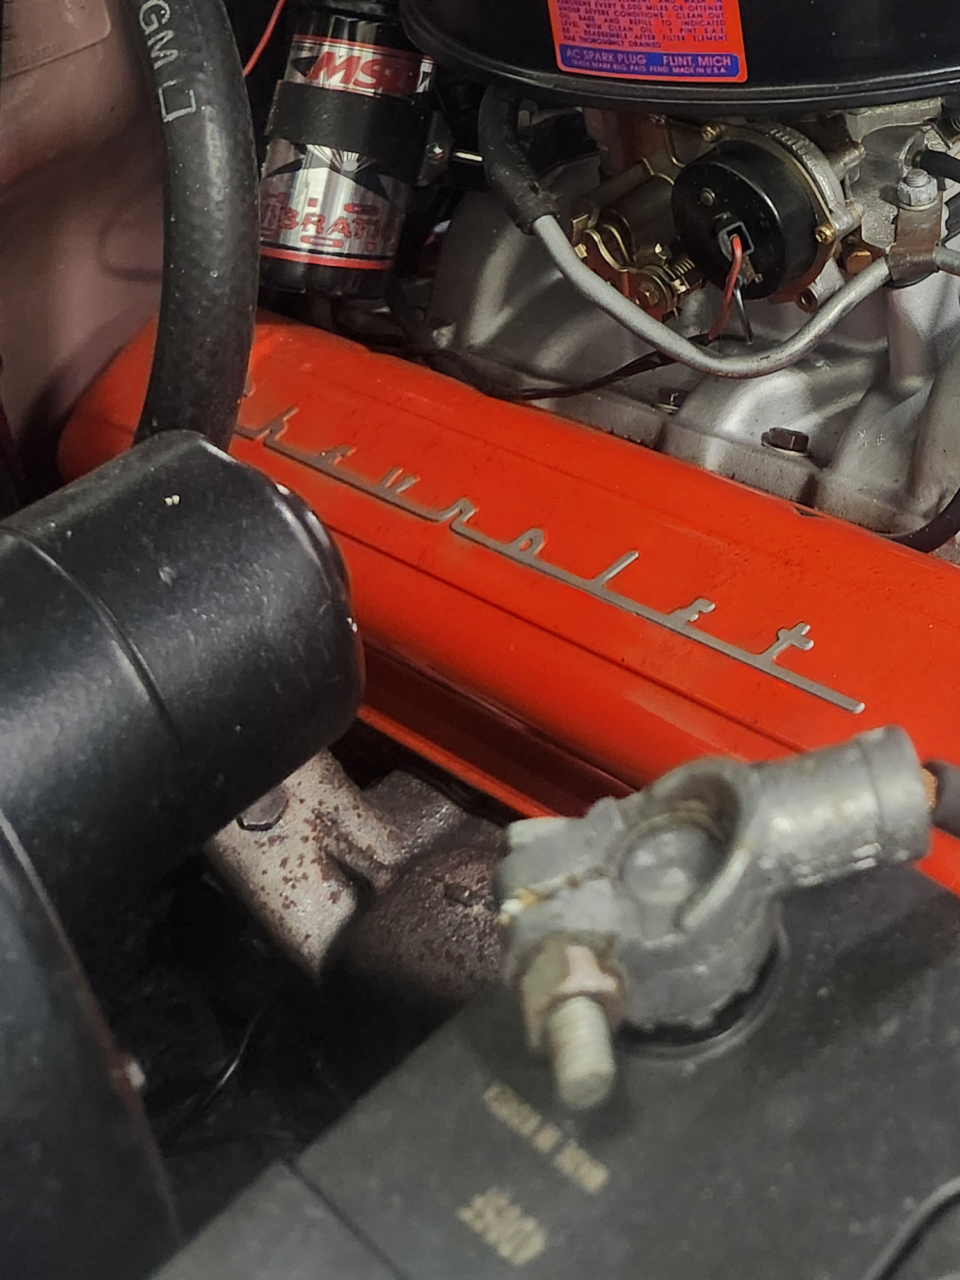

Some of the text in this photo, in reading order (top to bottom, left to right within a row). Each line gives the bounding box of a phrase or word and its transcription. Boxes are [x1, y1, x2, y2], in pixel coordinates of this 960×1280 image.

[646, 4, 669, 12] MILES
[614, 11, 664, 19] CONDITIONS
[608, 24, 633, 32] CLEAN
[139, 0, 179, 70] GM
[634, 33, 656, 41] AFTER
[662, 34, 686, 42] FILTER
[693, 34, 728, 42] ELEMENT
[566, 48, 581, 59] AC
[583, 50, 615, 62] SPARK
[617, 53, 647, 65] PLUG
[698, 55, 732, 66] MICH
[672, 66, 694, 74] MADE
[234, 380, 866, 712] hevrolet
